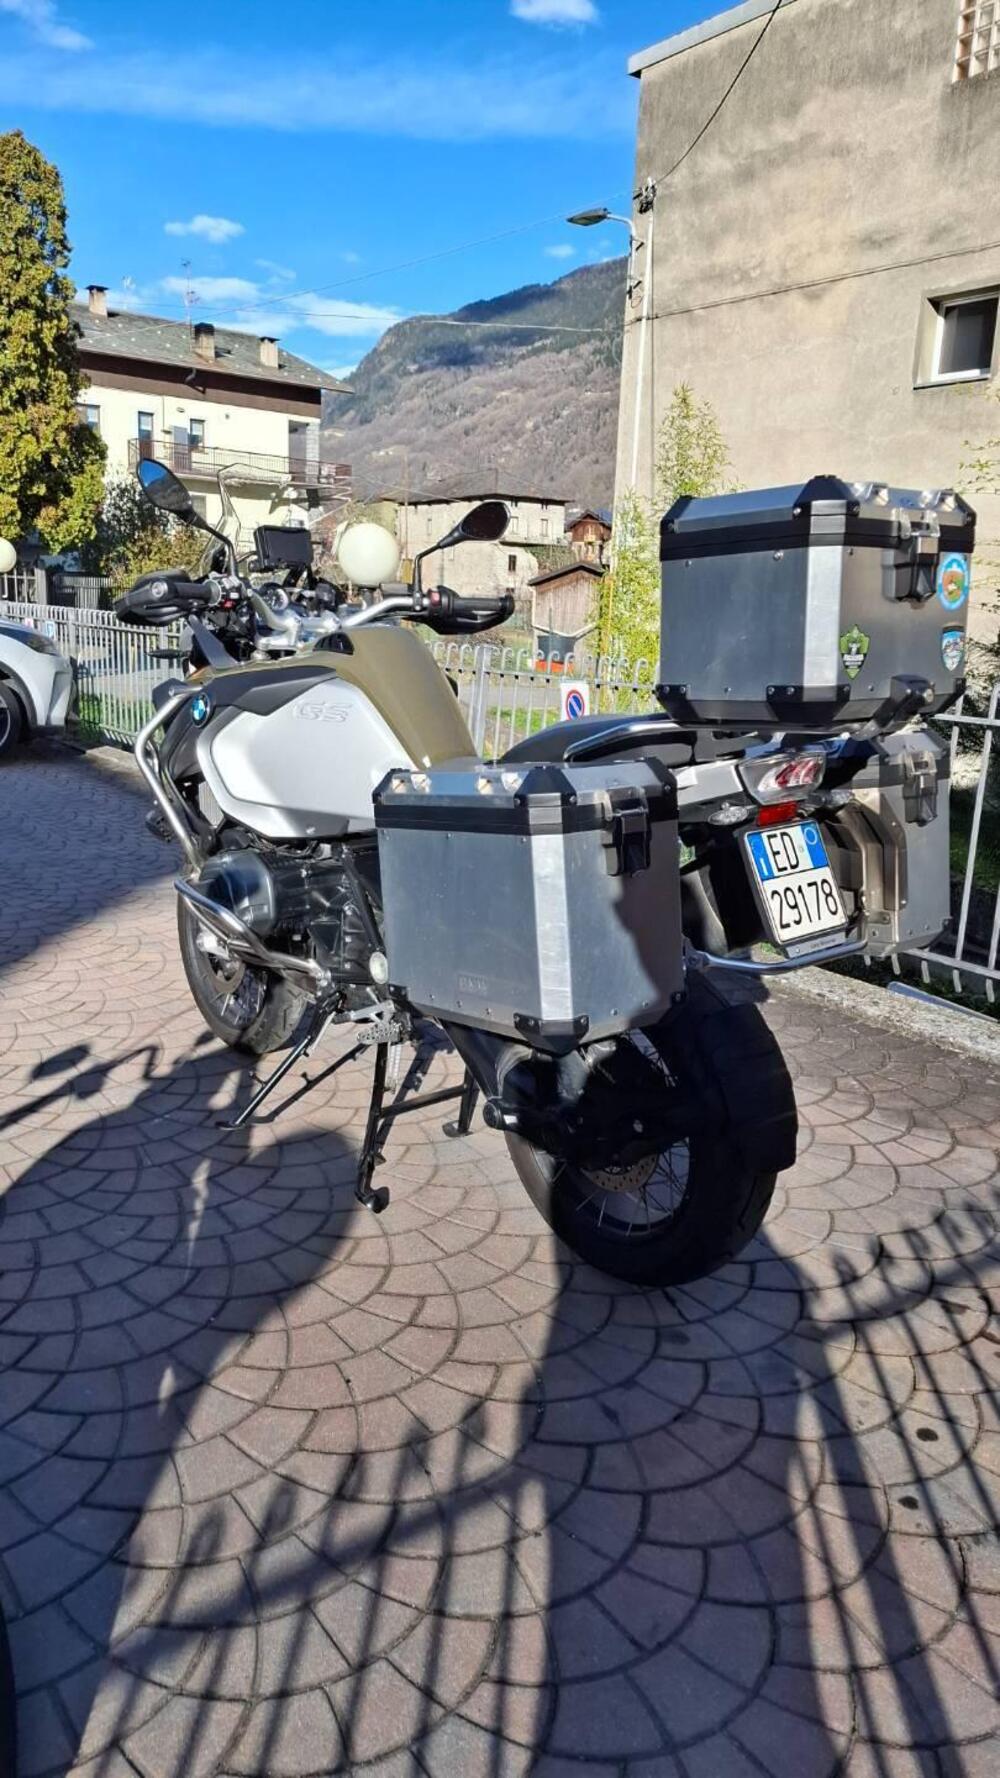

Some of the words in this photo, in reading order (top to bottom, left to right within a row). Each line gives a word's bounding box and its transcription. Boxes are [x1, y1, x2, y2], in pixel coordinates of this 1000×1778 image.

[296, 701, 353, 722] GS
[767, 832, 799, 872] ED
[771, 878, 838, 929] 29178
